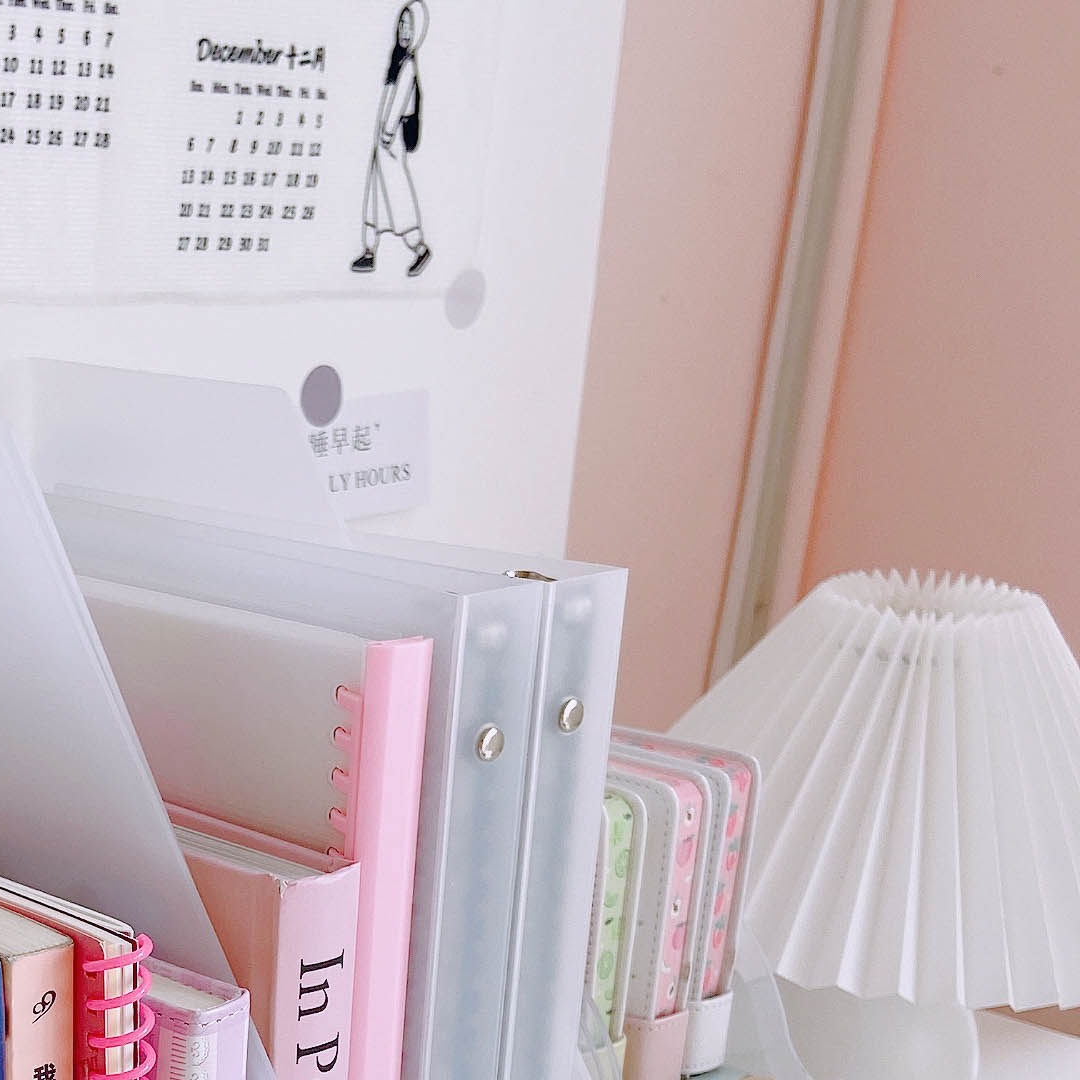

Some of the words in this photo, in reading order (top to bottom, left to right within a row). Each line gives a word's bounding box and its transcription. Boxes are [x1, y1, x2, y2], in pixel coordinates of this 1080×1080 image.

[8, 24, 17, 41] 3
[34, 26, 43, 40] 4
[57, 27, 65, 45] 5
[105, 31, 114, 48] 7
[197, 38, 283, 64] December
[2, 56, 19, 73] 10
[29, 58, 43, 76] 11
[51, 59, 67, 77] 12
[77, 61, 92, 78] 13
[98, 63, 115, 79] 14
[0, 91, 16, 108] 17
[26, 92, 42, 110] 18
[49, 94, 65, 111] 19
[95, 96, 110, 113] 21
[235, 110, 244, 126] 1
[256, 111, 265, 127] 2
[275, 111, 285, 128] 3
[0, 127, 16, 144] 24
[25, 129, 41, 146] 25
[47, 130, 63, 147] 26
[73, 131, 88, 147] 27
[93, 132, 111, 149] 28
[187, 136, 195, 152] 6
[206, 136, 216, 153] 7
[229, 138, 239, 154] 8
[249, 139, 258, 155] 9
[266, 140, 283, 156] 10
[181, 168, 196, 185] 13
[200, 170, 215, 185] 14
[223, 170, 238, 186] 15
[242, 171, 257, 187] 16
[261, 171, 278, 187] 17
[285, 172, 300, 188] 18
[305, 173, 319, 188] 19
[219, 203, 235, 219] 22
[239, 203, 254, 219] 23
[258, 204, 274, 220] 24
[177, 236, 191, 252] 27
[195, 236, 209, 252] 28
[217, 236, 233, 251] 29
[239, 237, 253, 252] 30
[255, 237, 271, 253] 31
[354, 463, 412, 489] HOURS
[298, 948, 345, 1022] In
